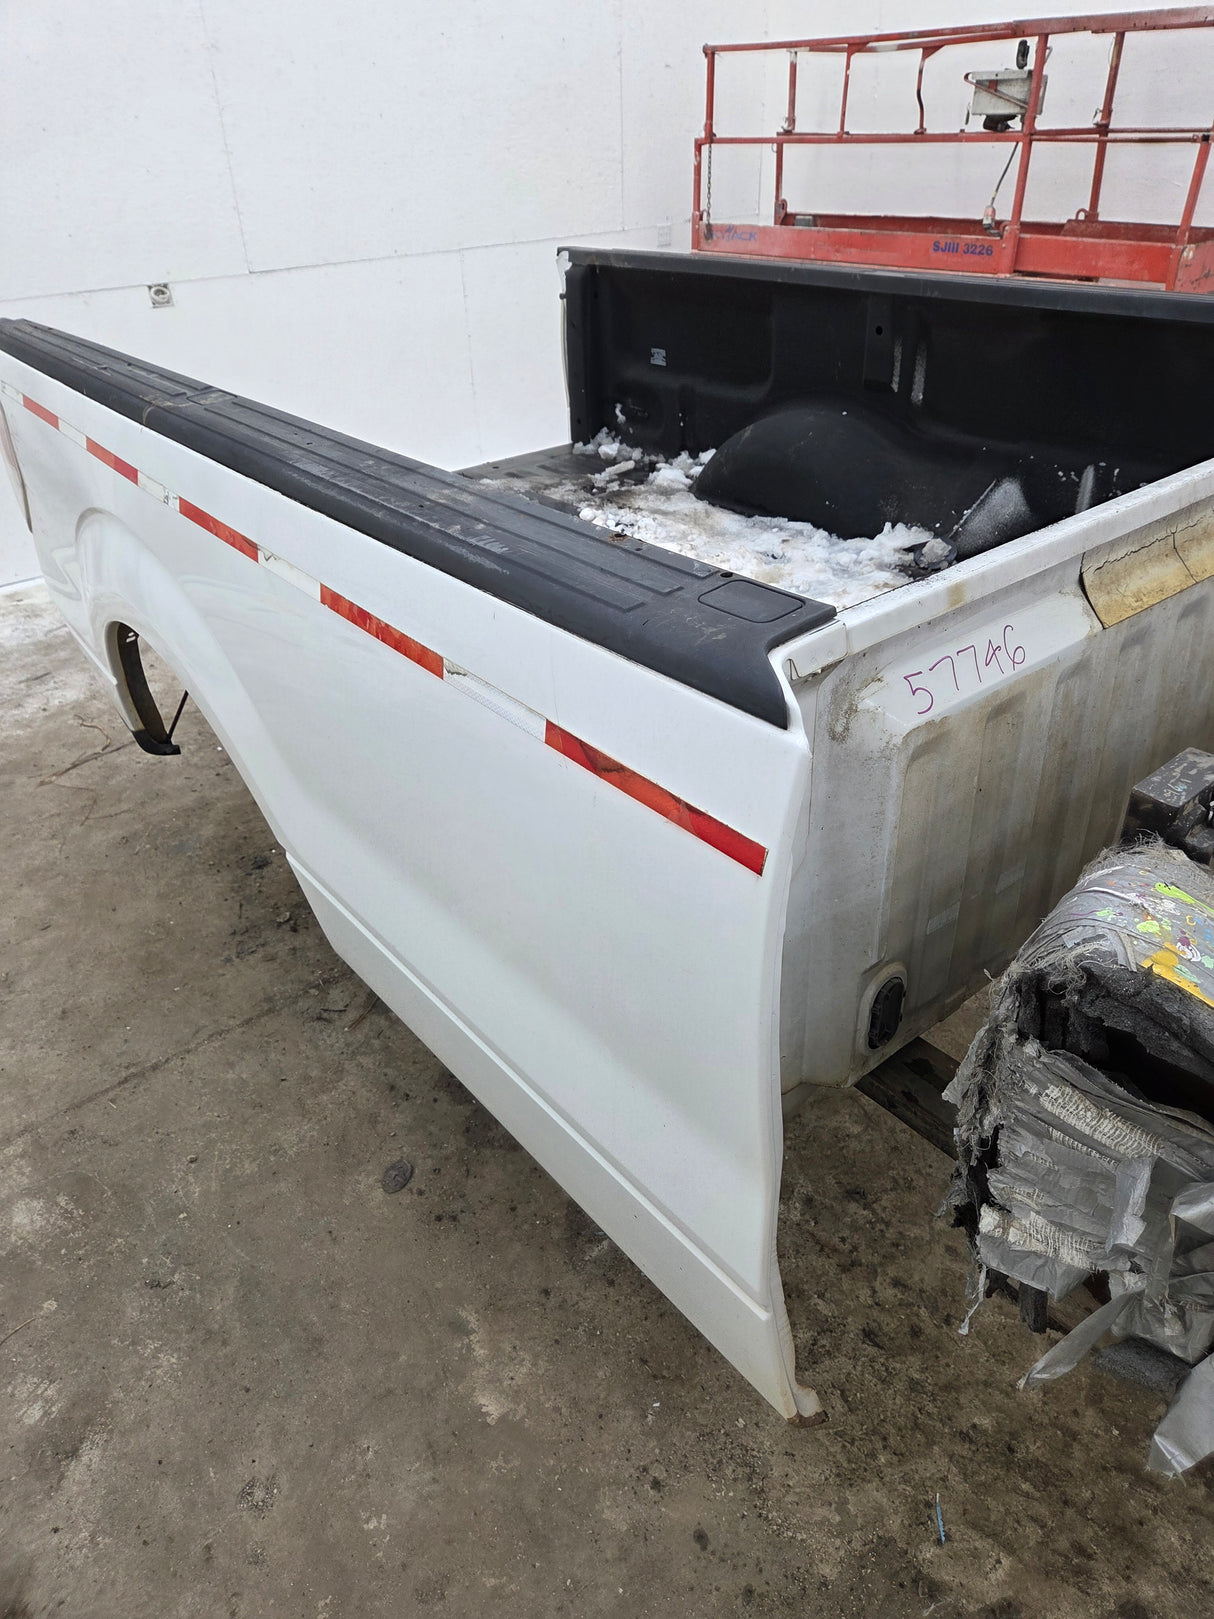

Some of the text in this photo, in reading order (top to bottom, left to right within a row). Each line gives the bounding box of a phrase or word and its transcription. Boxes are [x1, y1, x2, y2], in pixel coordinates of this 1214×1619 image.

[932, 240, 994, 257] SJIII 3226
[903, 624, 1026, 714] 57746
